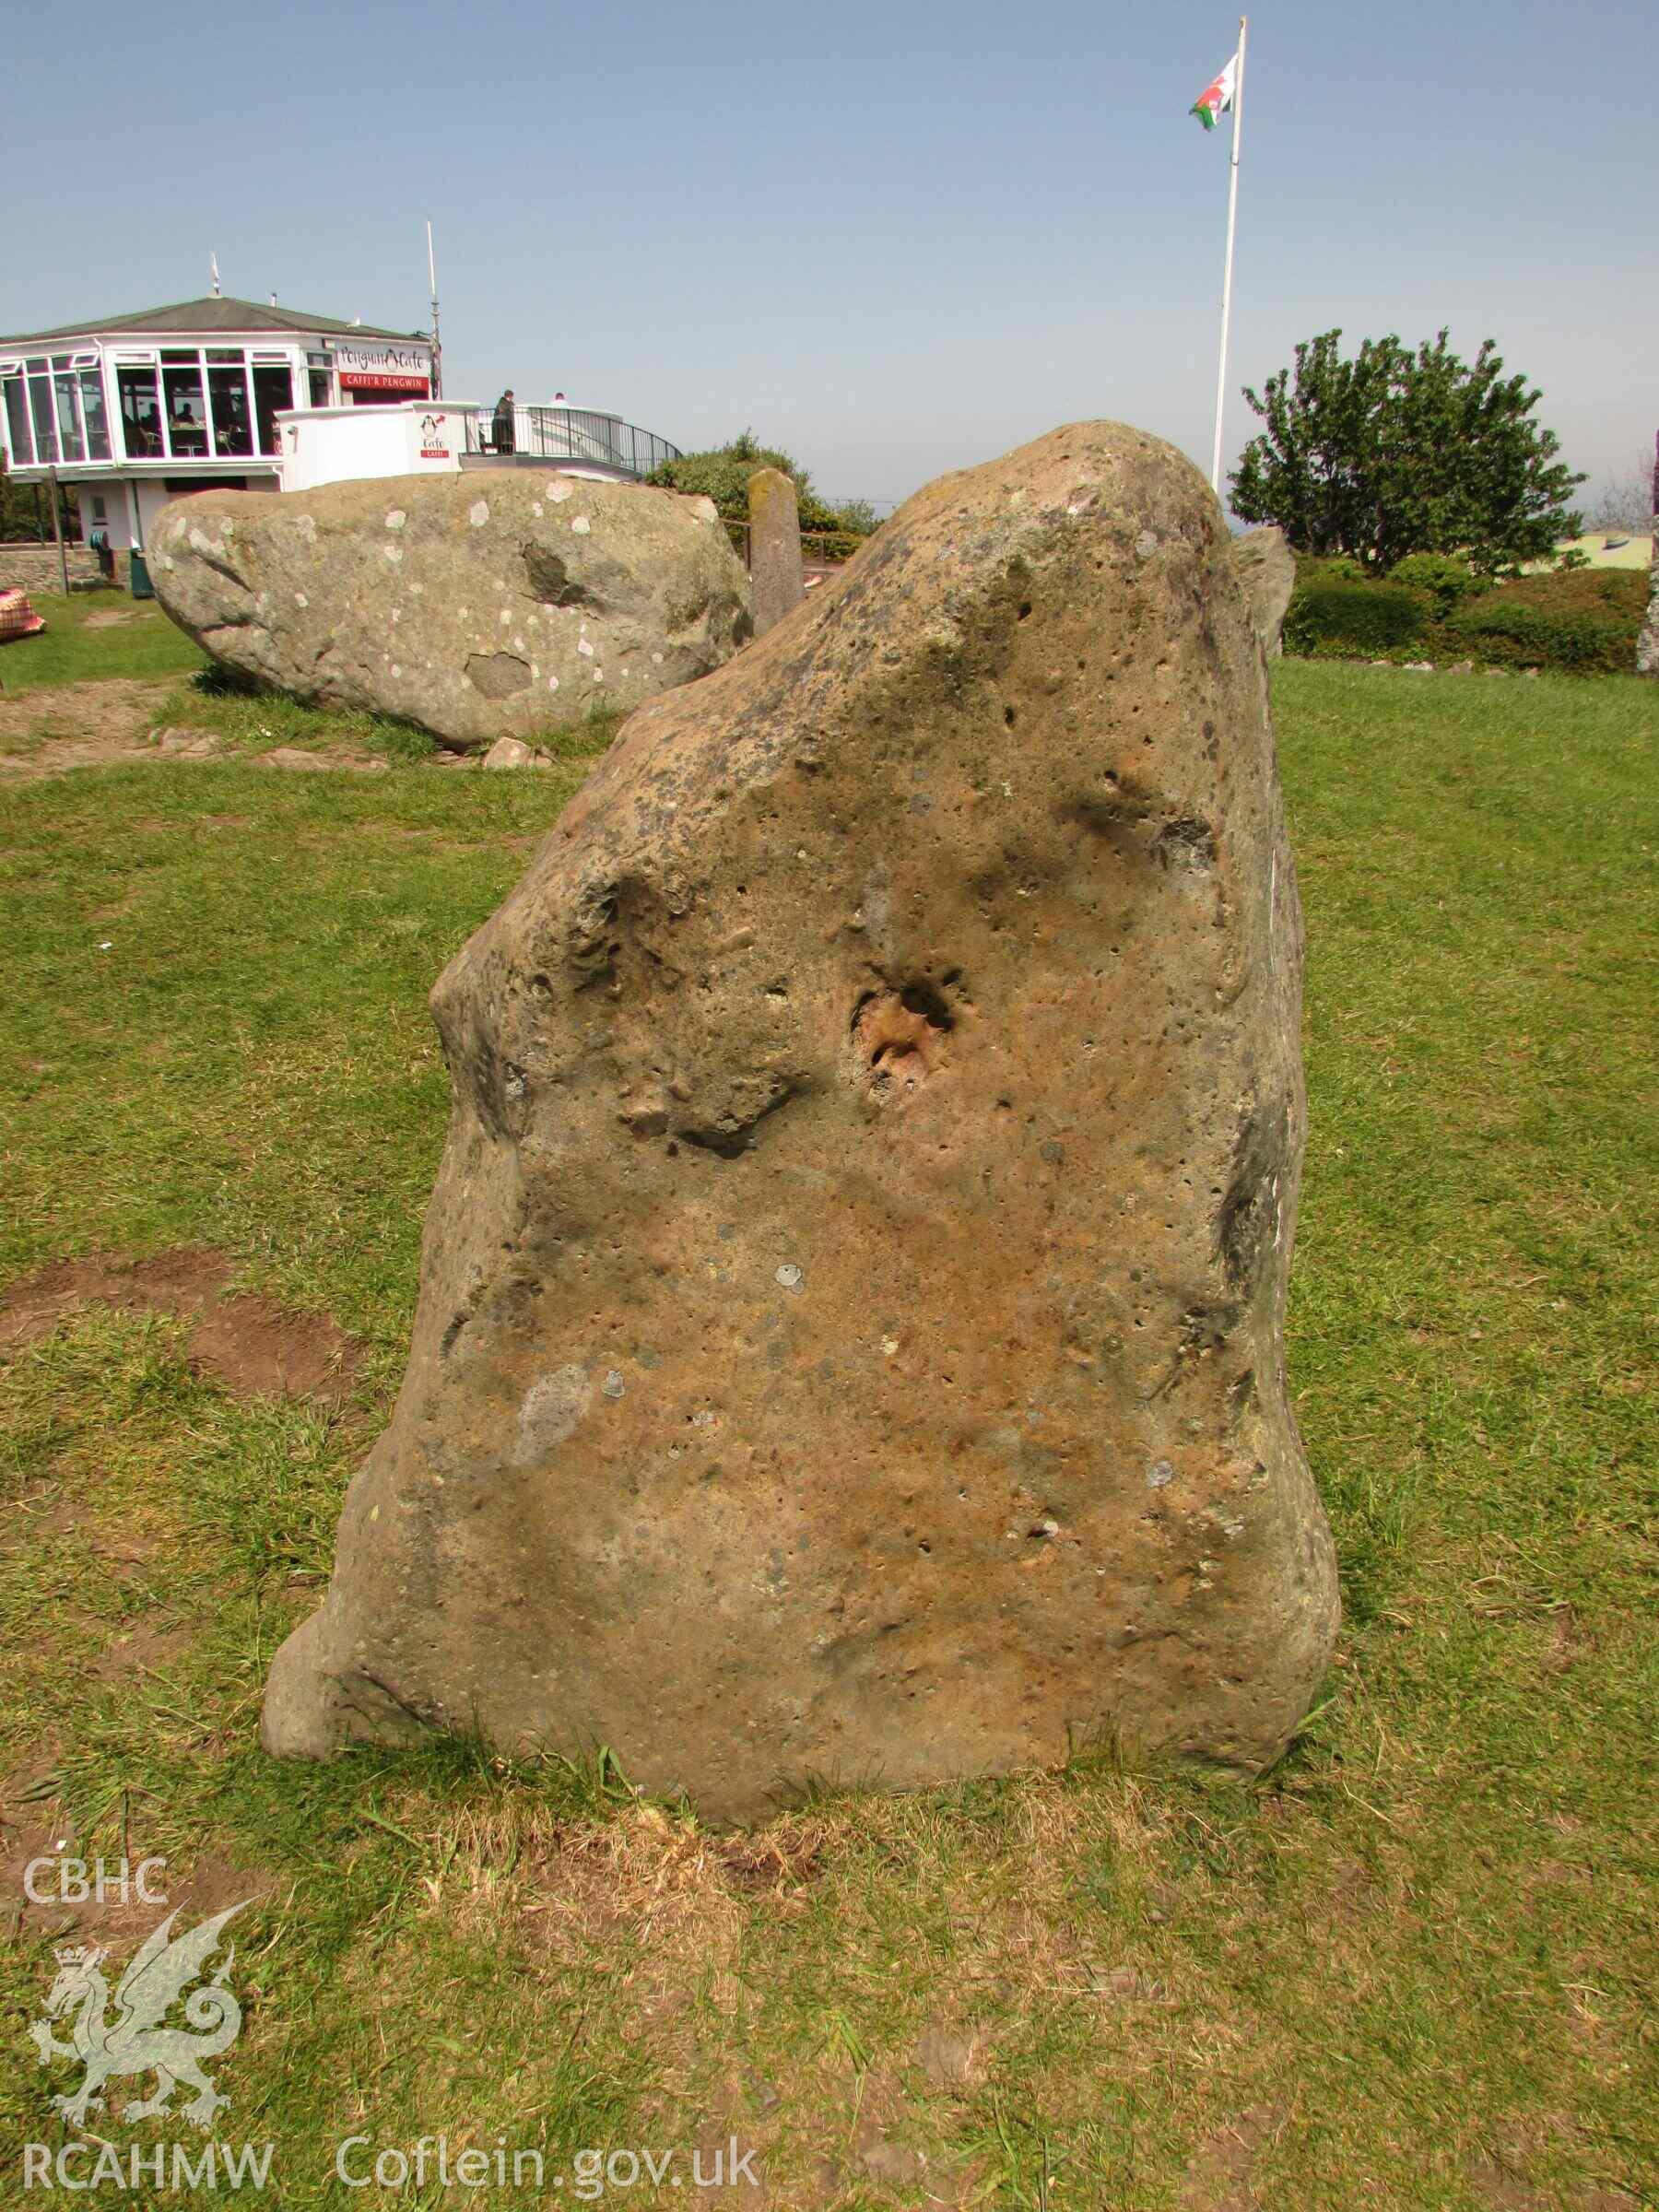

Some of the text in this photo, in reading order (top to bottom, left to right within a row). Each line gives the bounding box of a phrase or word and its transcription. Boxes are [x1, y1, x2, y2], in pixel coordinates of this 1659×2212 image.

[341, 347, 385, 370] Penguin
[347, 375, 422, 387] CAFFI'R PENGWIN
